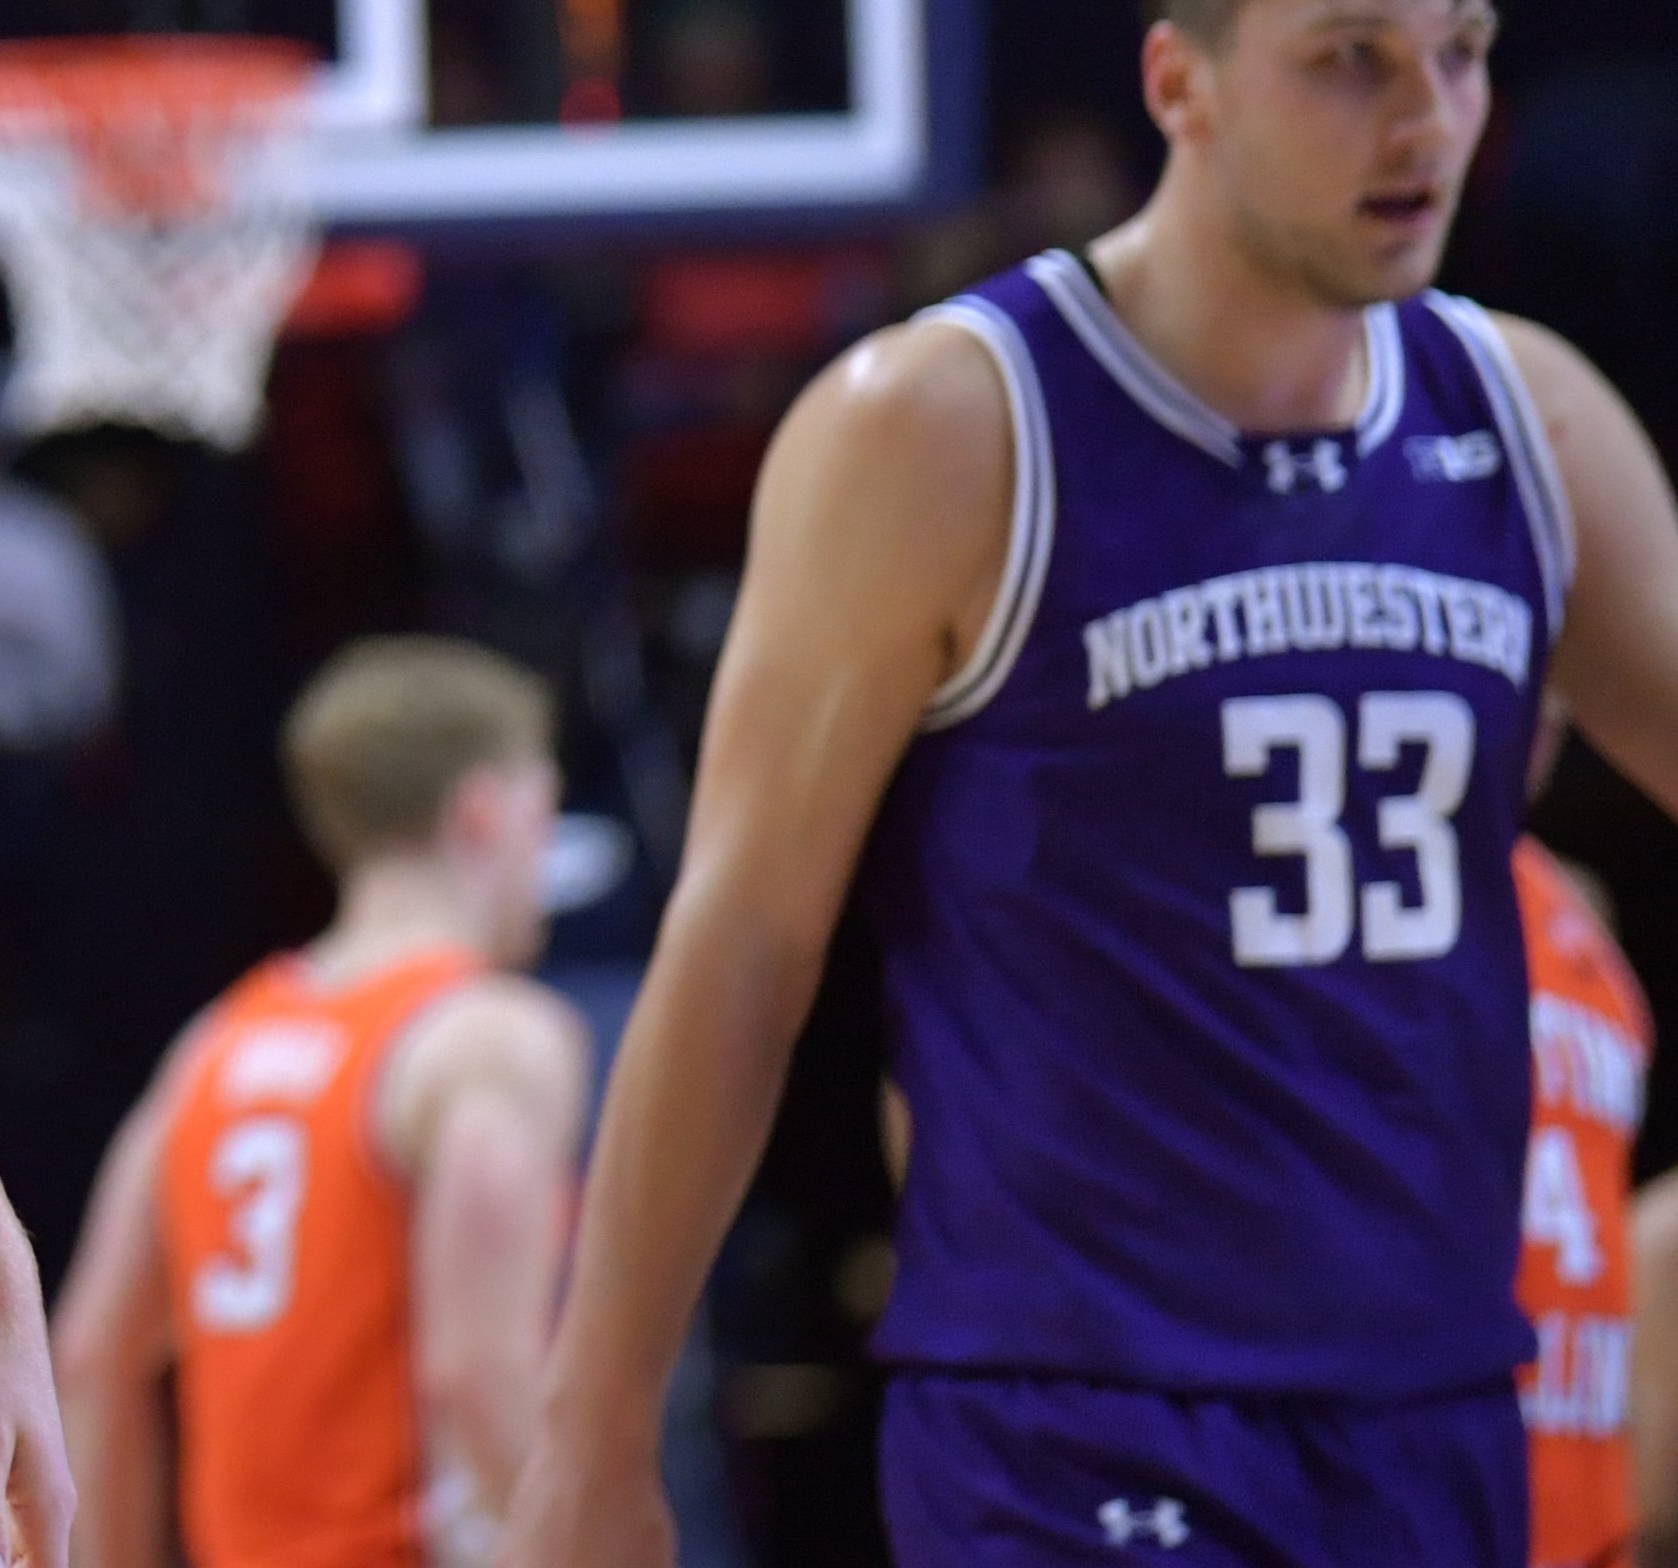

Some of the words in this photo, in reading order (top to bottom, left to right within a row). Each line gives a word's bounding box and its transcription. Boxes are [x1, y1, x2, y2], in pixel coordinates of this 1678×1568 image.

[1082, 559, 1535, 712] NORTHWESTERN
[1220, 689, 1477, 969] 33
[188, 1112, 311, 1332] 3
